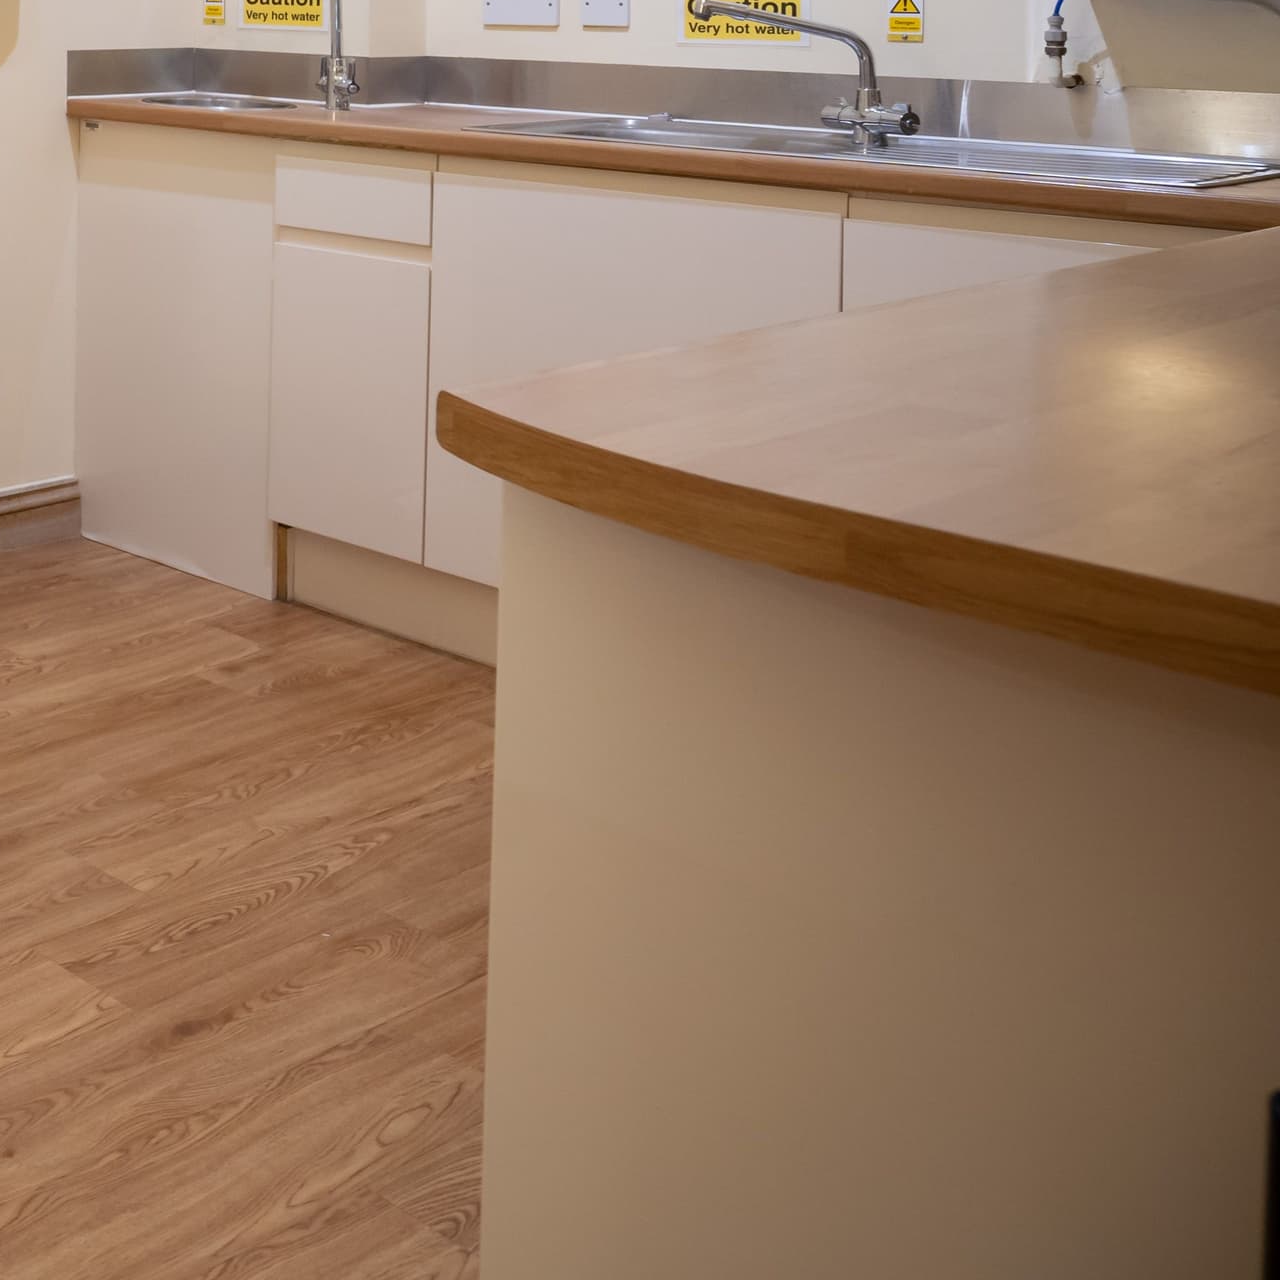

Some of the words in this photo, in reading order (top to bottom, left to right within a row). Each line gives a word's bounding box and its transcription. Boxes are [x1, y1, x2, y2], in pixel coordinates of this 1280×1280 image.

[246, 9, 269, 23] Very
[271, 10, 289, 21] hot
[291, 12, 320, 22] water
[688, 22, 720, 36] Very
[726, 23, 749, 34] hot
